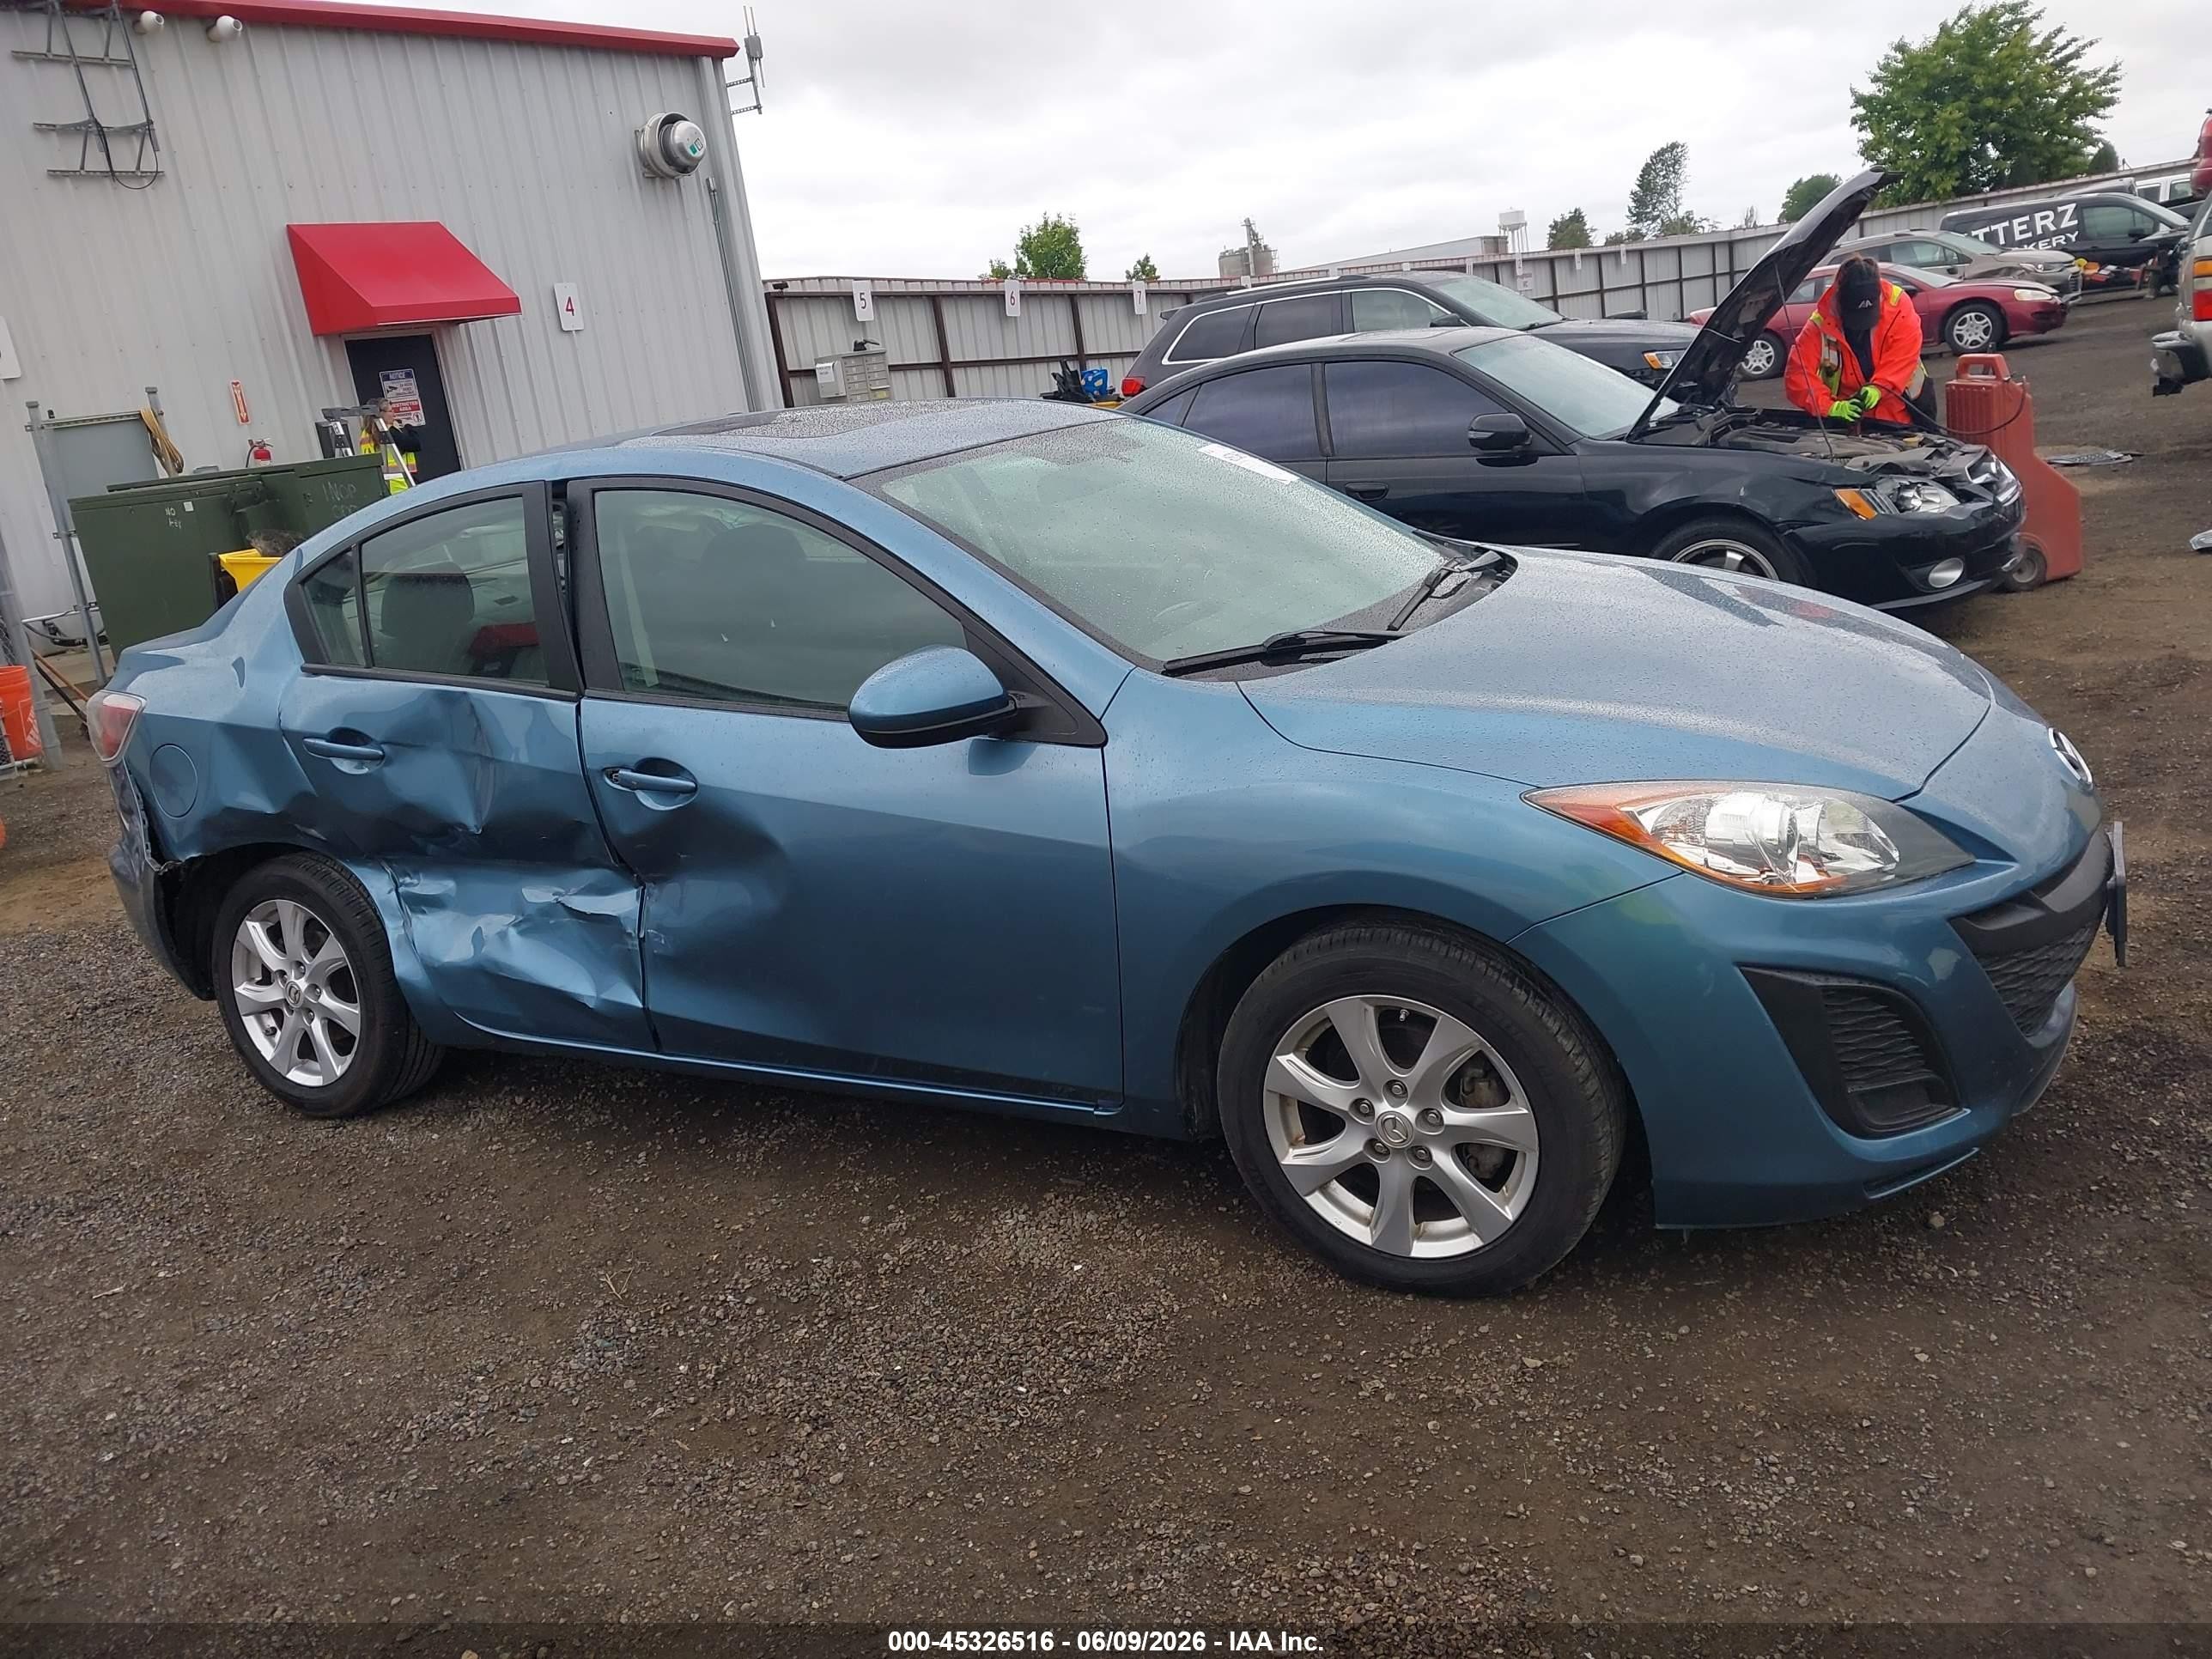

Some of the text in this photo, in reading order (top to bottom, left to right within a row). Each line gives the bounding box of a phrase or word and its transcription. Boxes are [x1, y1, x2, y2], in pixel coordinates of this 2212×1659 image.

[1971, 203, 2079, 246] TTERZ
[2013, 230, 2079, 251] KERY
[565, 296, 575, 317] 4
[859, 292, 867, 310] 5
[1010, 290, 1016, 307] 6
[1137, 290, 1142, 305] 7
